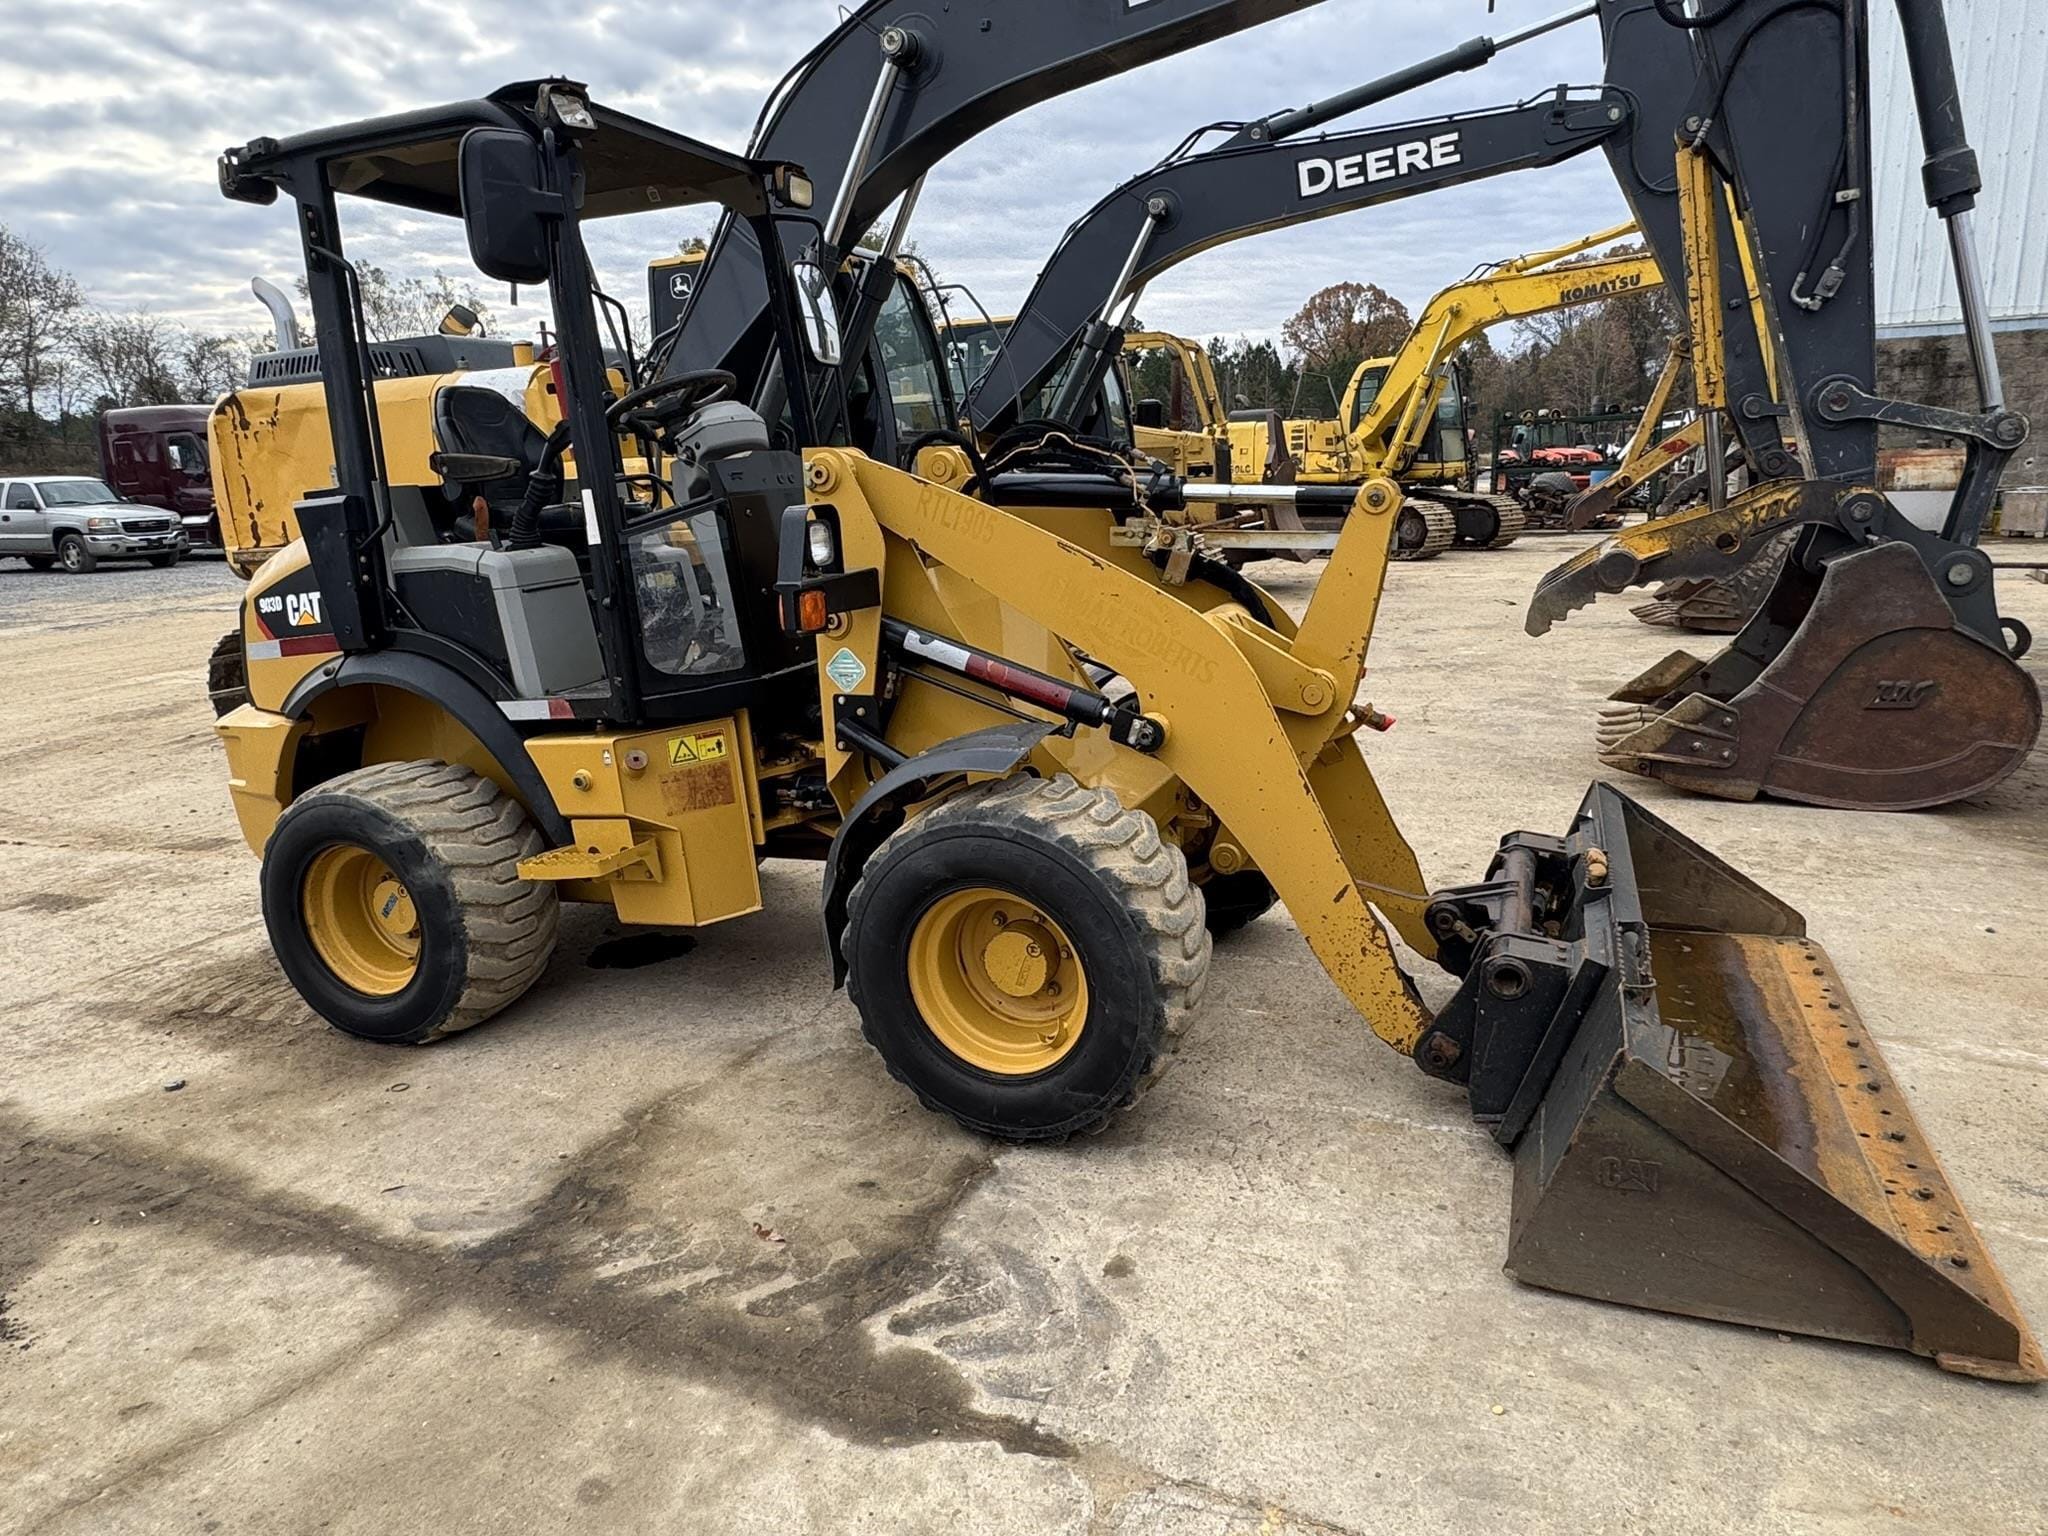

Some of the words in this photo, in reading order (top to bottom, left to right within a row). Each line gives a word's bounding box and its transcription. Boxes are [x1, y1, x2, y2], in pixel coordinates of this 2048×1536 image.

[1297, 132, 1461, 197] DEERE
[1560, 273, 1641, 302] KOMATSU
[915, 489, 996, 543] RTL1905
[259, 596, 283, 614] 903D
[286, 591, 322, 627] CAT
[1122, 616, 1220, 684] ROBERTS
[1597, 1155, 1664, 1193] CAT
